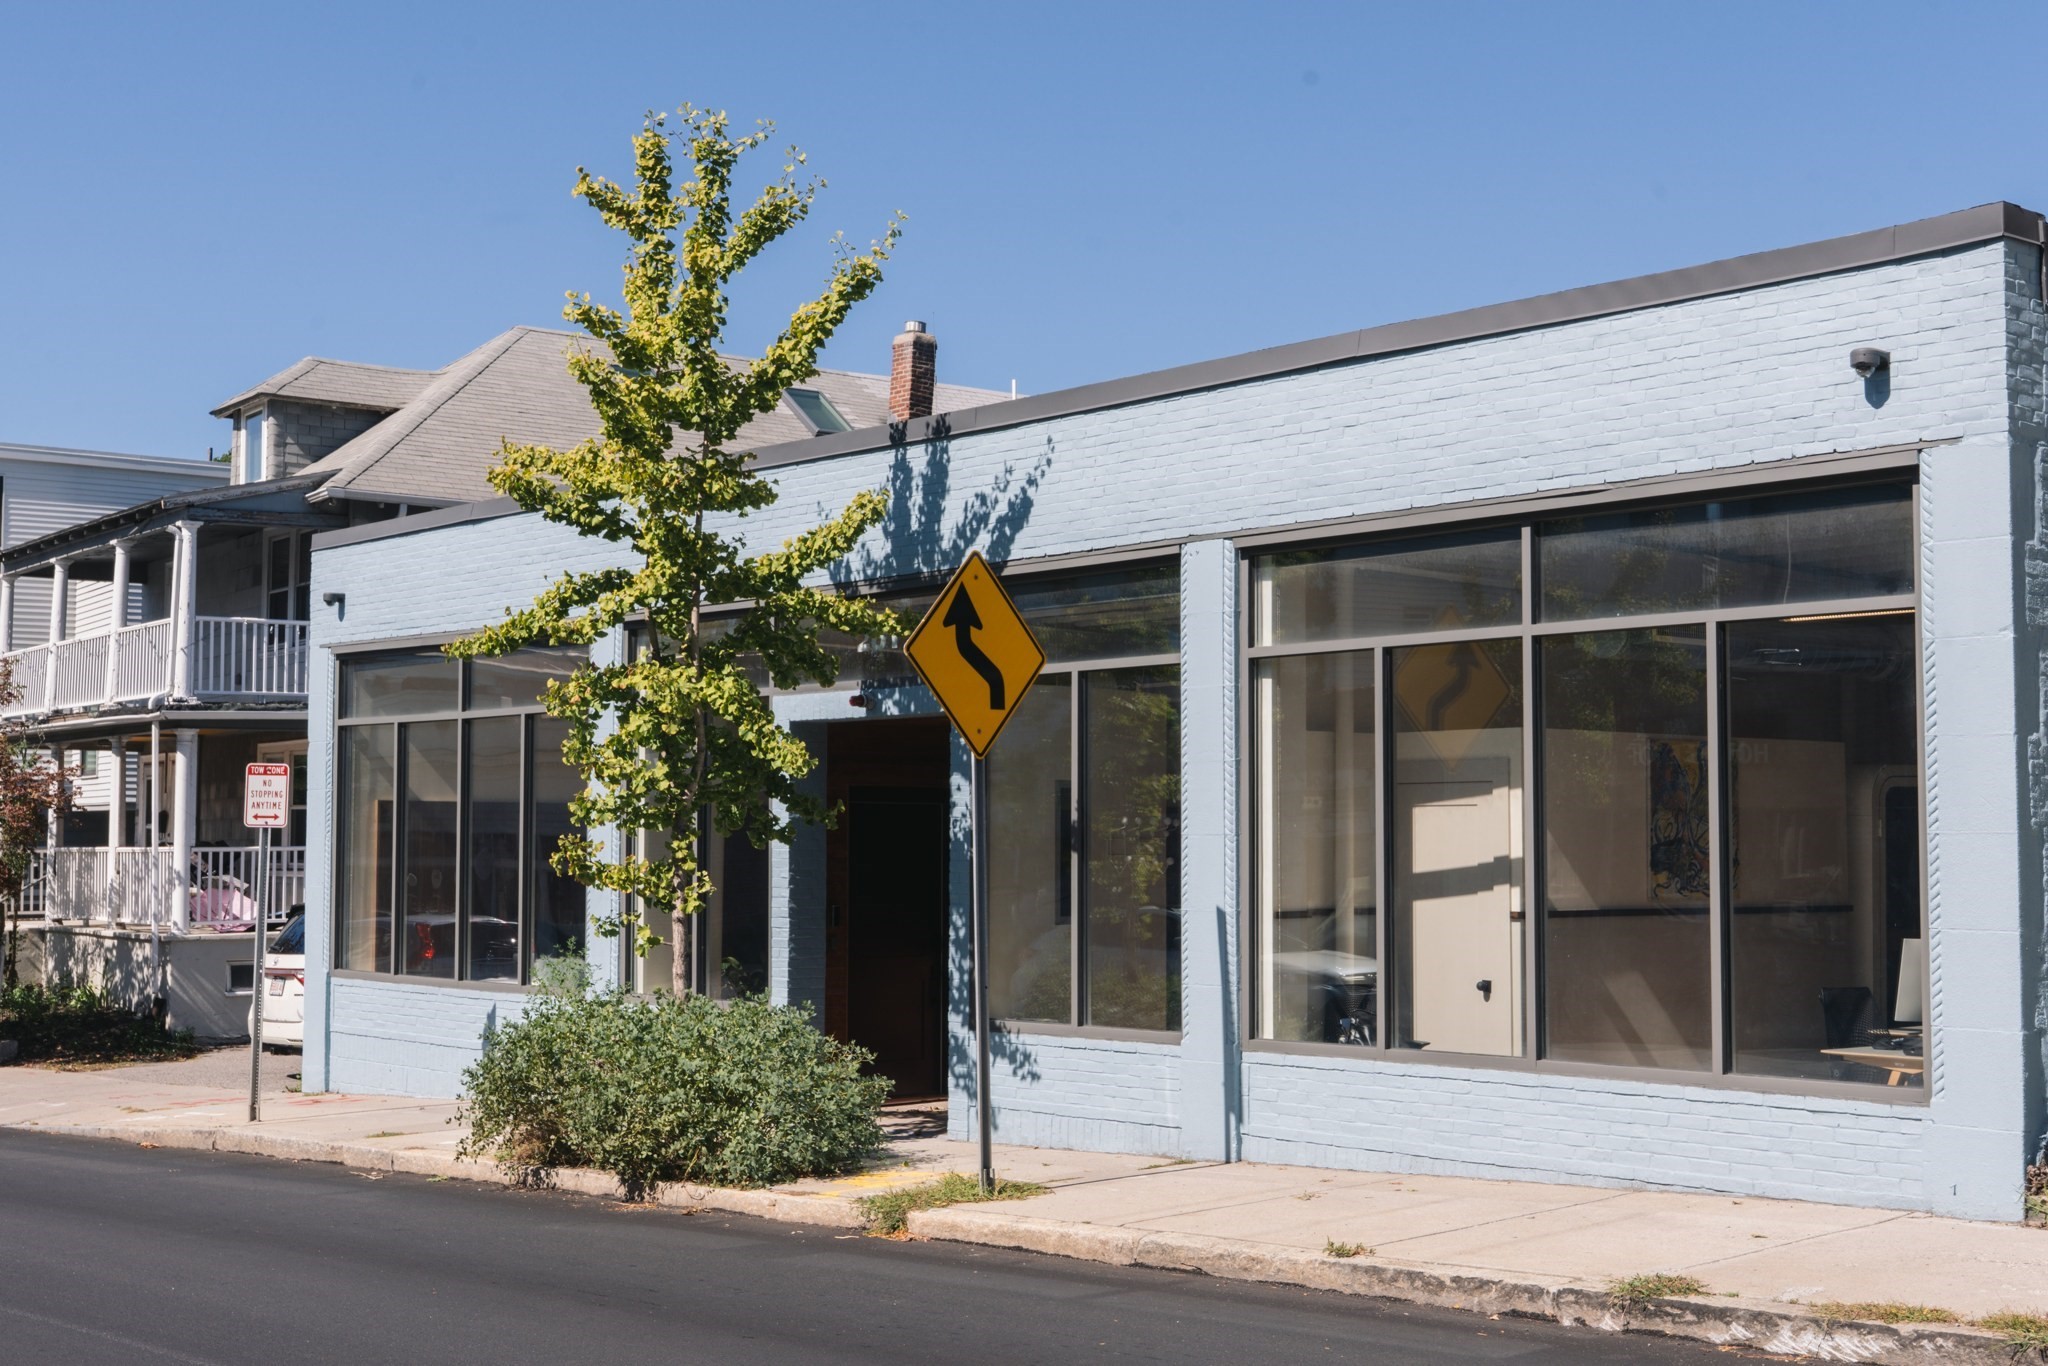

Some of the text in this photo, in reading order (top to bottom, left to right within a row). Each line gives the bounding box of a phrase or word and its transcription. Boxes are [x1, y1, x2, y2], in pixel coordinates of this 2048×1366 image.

[251, 766, 286, 775] TOW ZONE
[262, 779, 272, 787] NO
[250, 790, 284, 799] STOPPING
[251, 801, 282, 810] ANYTIME
